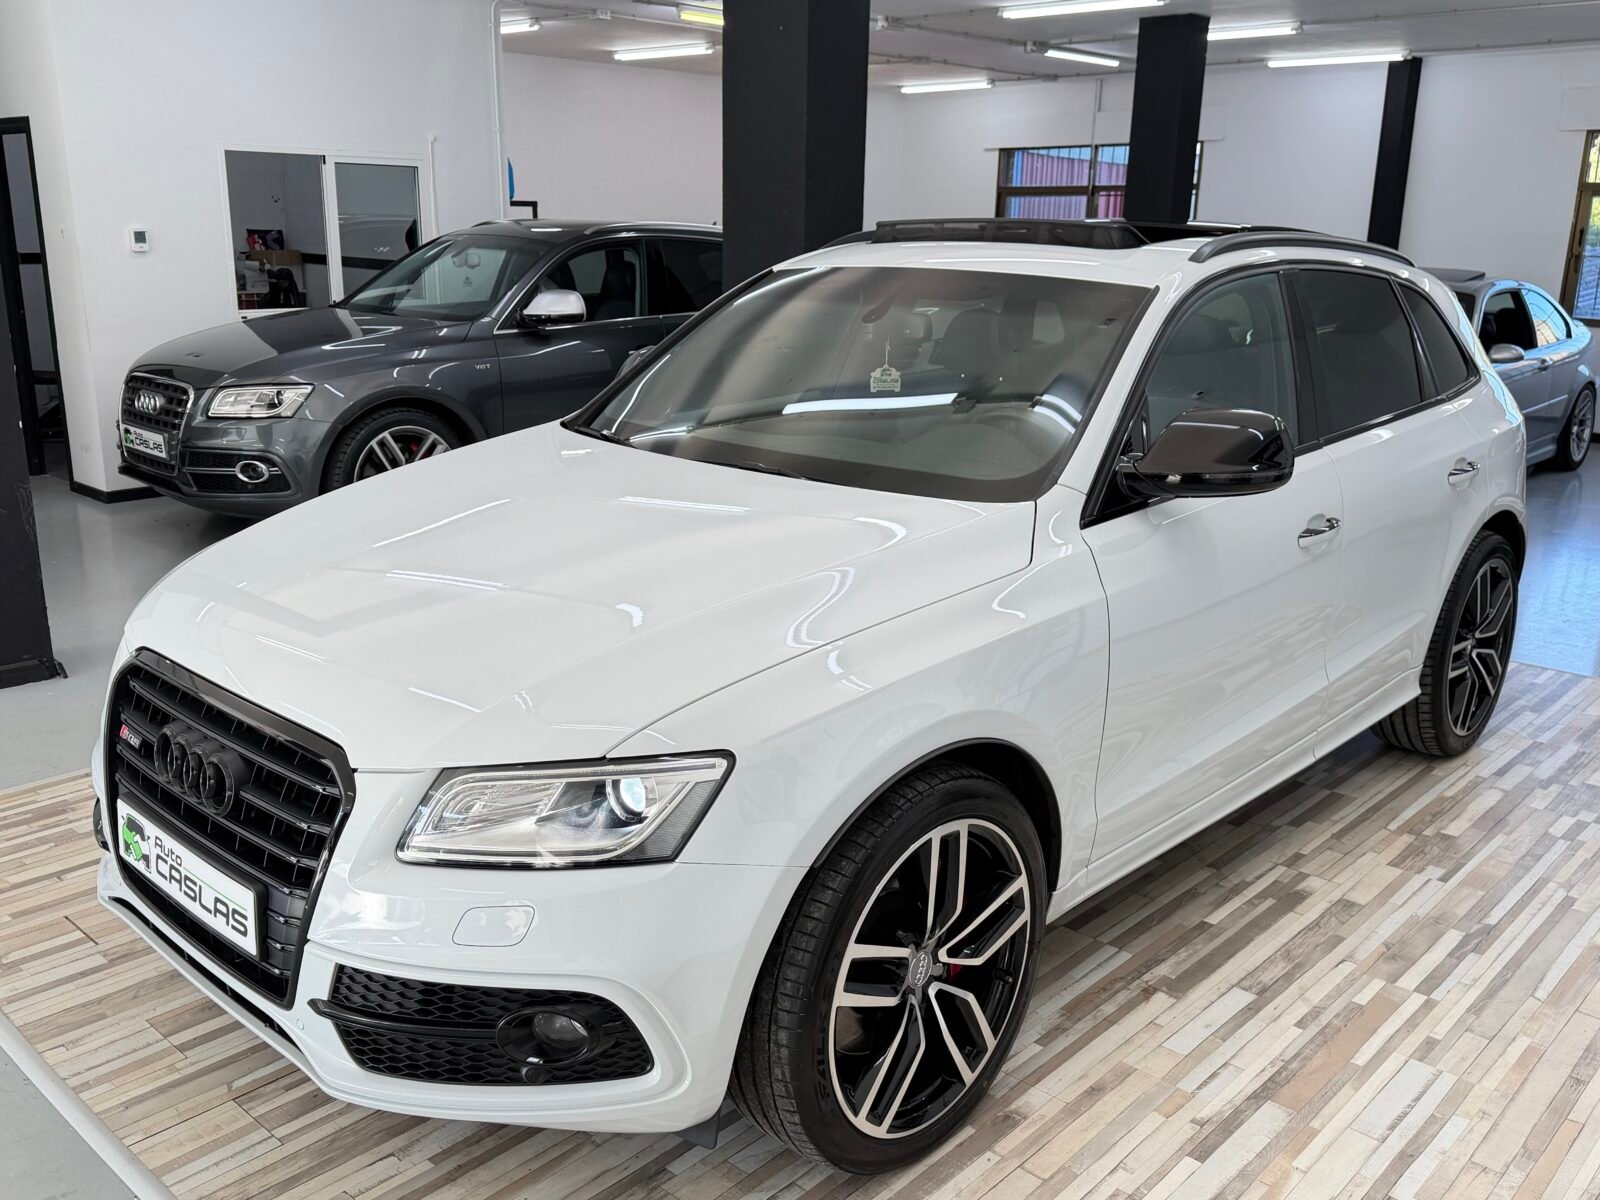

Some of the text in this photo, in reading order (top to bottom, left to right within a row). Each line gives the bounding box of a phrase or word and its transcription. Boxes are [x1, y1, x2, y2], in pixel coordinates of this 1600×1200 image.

[135, 437, 163, 453] CASLAS
[154, 835, 182, 867] Auto
[156, 853, 248, 938] CASLAS
